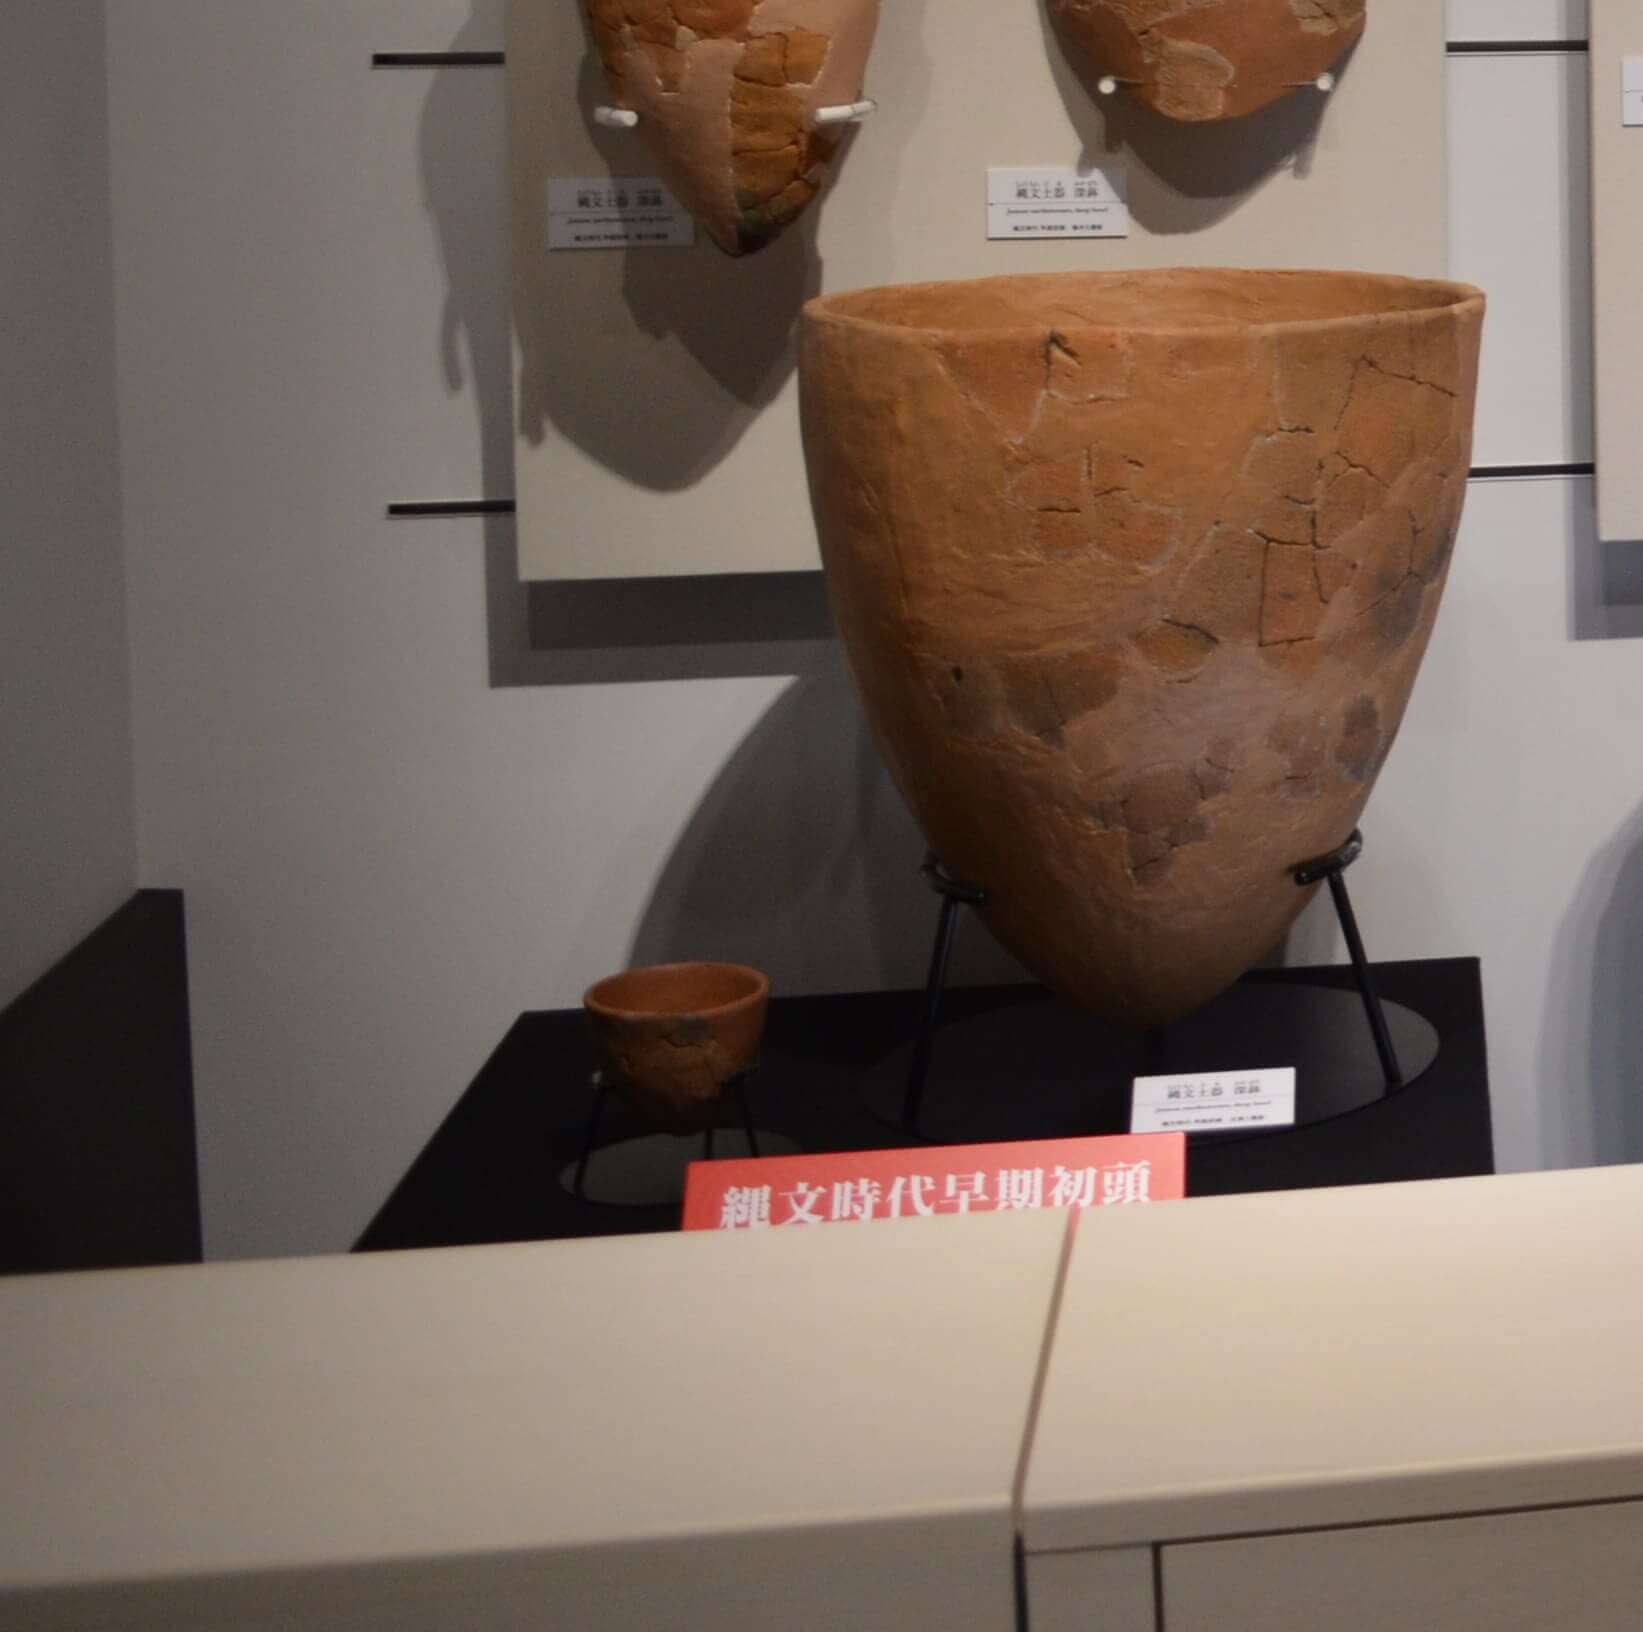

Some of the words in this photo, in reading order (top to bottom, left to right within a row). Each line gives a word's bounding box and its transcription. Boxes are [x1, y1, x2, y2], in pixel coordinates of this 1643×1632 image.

[720, 1160, 1152, 1230] 縄文時代早期初頭
